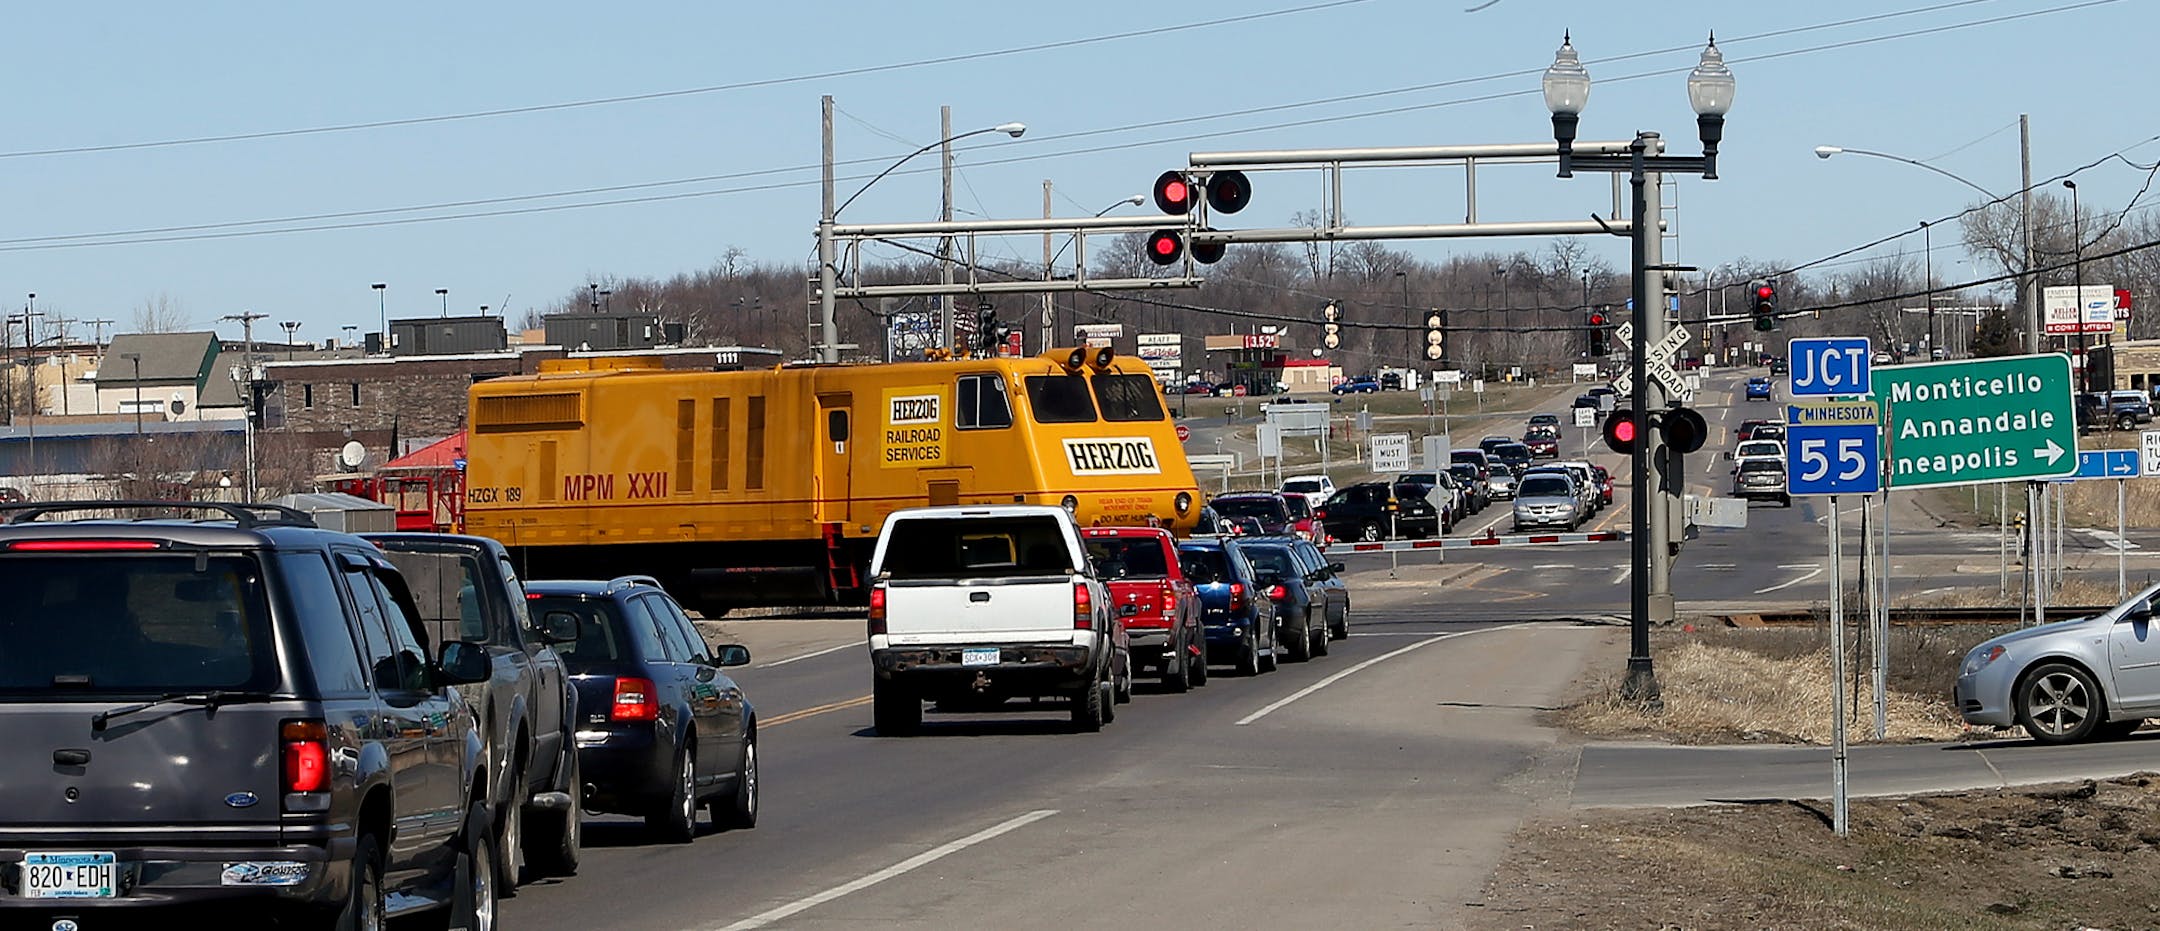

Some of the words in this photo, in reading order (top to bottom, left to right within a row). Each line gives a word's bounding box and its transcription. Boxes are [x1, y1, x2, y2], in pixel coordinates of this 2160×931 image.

[2078, 323, 2112, 331] UTTERS
[716, 352, 738, 364] 1111
[1795, 348, 1865, 387] JCT
[1891, 373, 2042, 403] Monticello
[893, 399, 937, 421] HERZOG
[1805, 406, 1875, 420] MINNESOTA
[1900, 409, 2054, 440] Annandale
[886, 429, 941, 444] RAILROAD
[2146, 435, 2160, 445] RI
[886, 446, 941, 461] SERVICES
[1068, 443, 1155, 470] HERZOG
[1380, 449, 1400, 457] MUST
[1801, 439, 1867, 482] 55
[1880, 446, 2019, 476] neapolis
[468, 488, 498, 503] HZGX
[504, 487, 521, 501] 189
[564, 474, 614, 500] MPM
[627, 472, 668, 498] XXII
[1100, 515, 1112, 523] DO
[1114, 514, 1129, 522] NOT
[30, 866, 63, 888] 820
[78, 865, 110, 888] EDH
